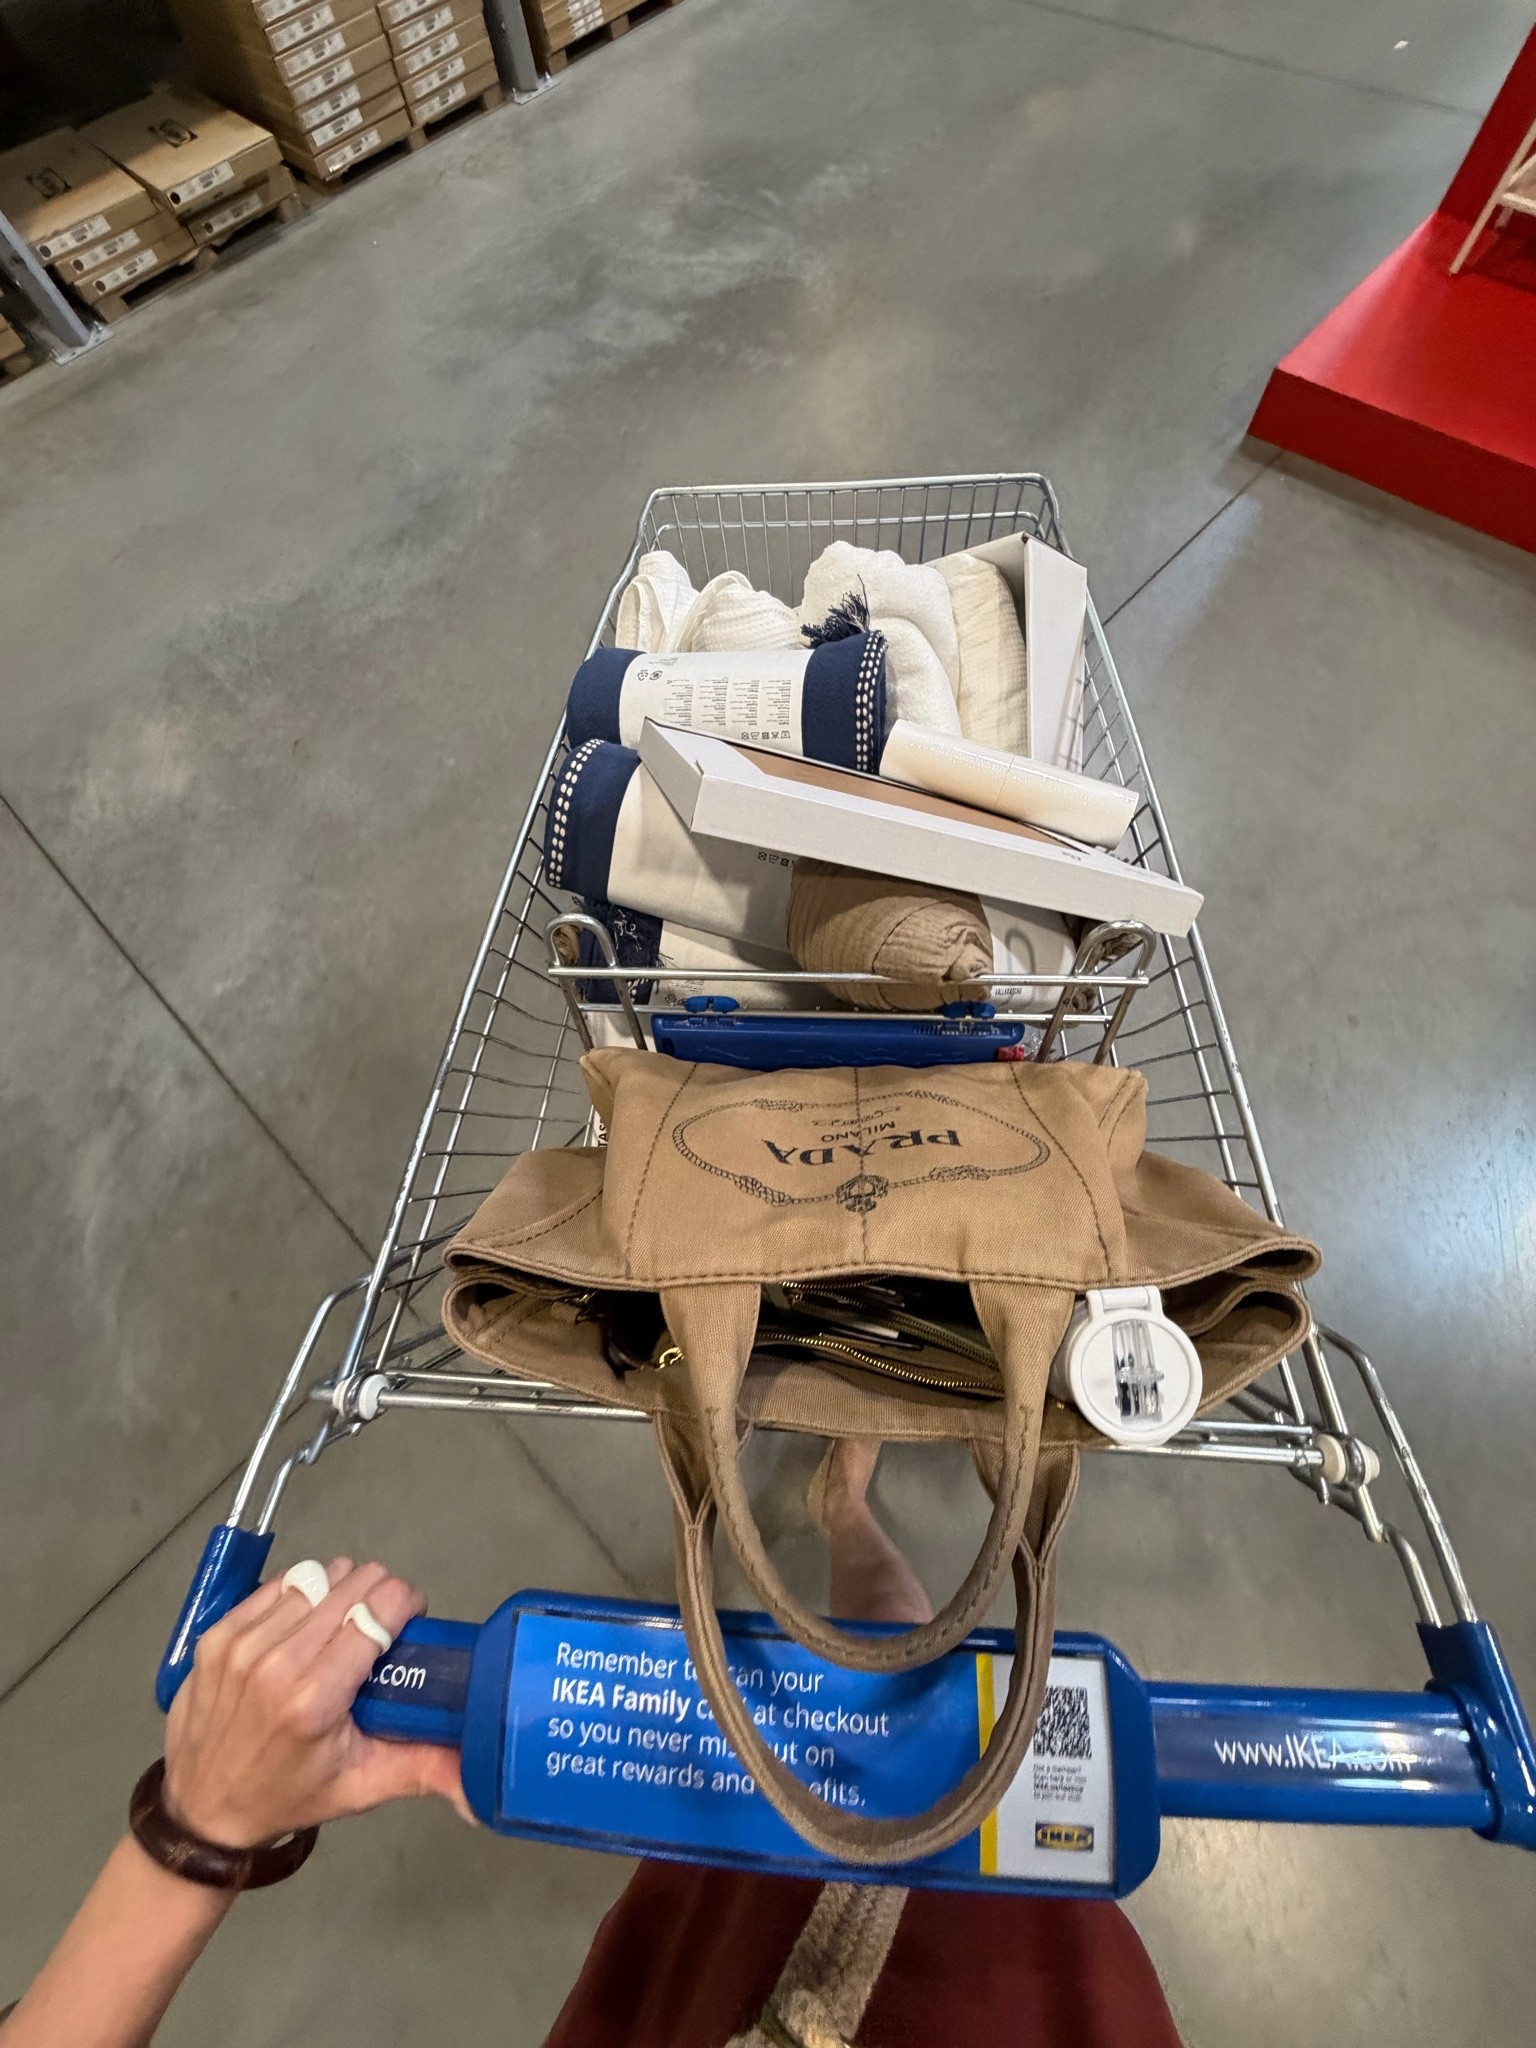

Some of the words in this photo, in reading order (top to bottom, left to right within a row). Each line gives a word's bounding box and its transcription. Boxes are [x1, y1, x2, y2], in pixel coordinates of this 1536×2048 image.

[761, 1129, 963, 1166] PRADA
[821, 1120, 896, 1143] MILANO
[556, 1641, 678, 1680] Remember
[770, 1669, 824, 1697] your
[552, 1677, 606, 1709] IKEA
[612, 1683, 691, 1724] Family
[753, 1702, 777, 1726] at
[783, 1701, 890, 1738] checkout
[548, 1717, 574, 1740] so
[578, 1720, 621, 1748] you
[627, 1726, 693, 1753] never
[804, 1745, 835, 1768] on
[546, 1751, 606, 1778] great
[612, 1762, 705, 1789] rewards
